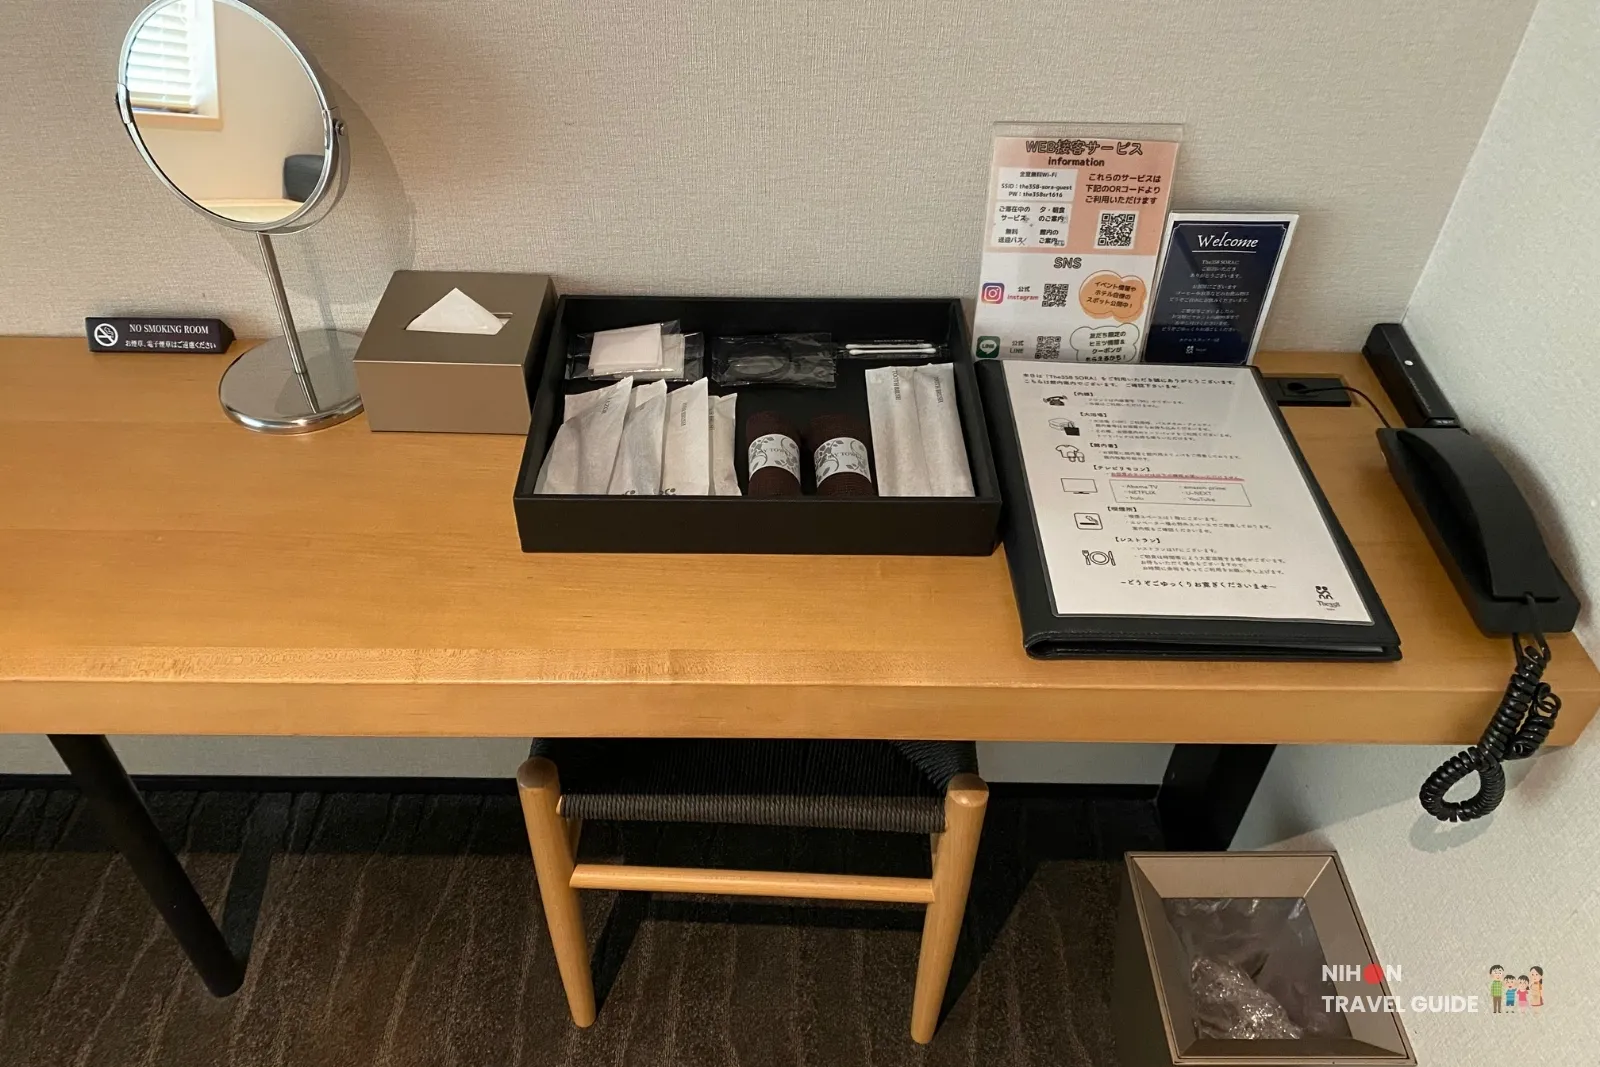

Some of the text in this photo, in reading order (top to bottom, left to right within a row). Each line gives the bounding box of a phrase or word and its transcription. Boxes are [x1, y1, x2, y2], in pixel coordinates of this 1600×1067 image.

[1025, 139, 1143, 156] WEB接客サービス
[1048, 156, 1105, 167] information
[1088, 173, 1161, 183] これらのサービスは
[1085, 195, 1158, 204] ご利用いただけます
[1197, 231, 1259, 248] Welcome
[1053, 256, 1082, 269] SNS
[129, 324, 209, 334] NO SMOKING ROOM
